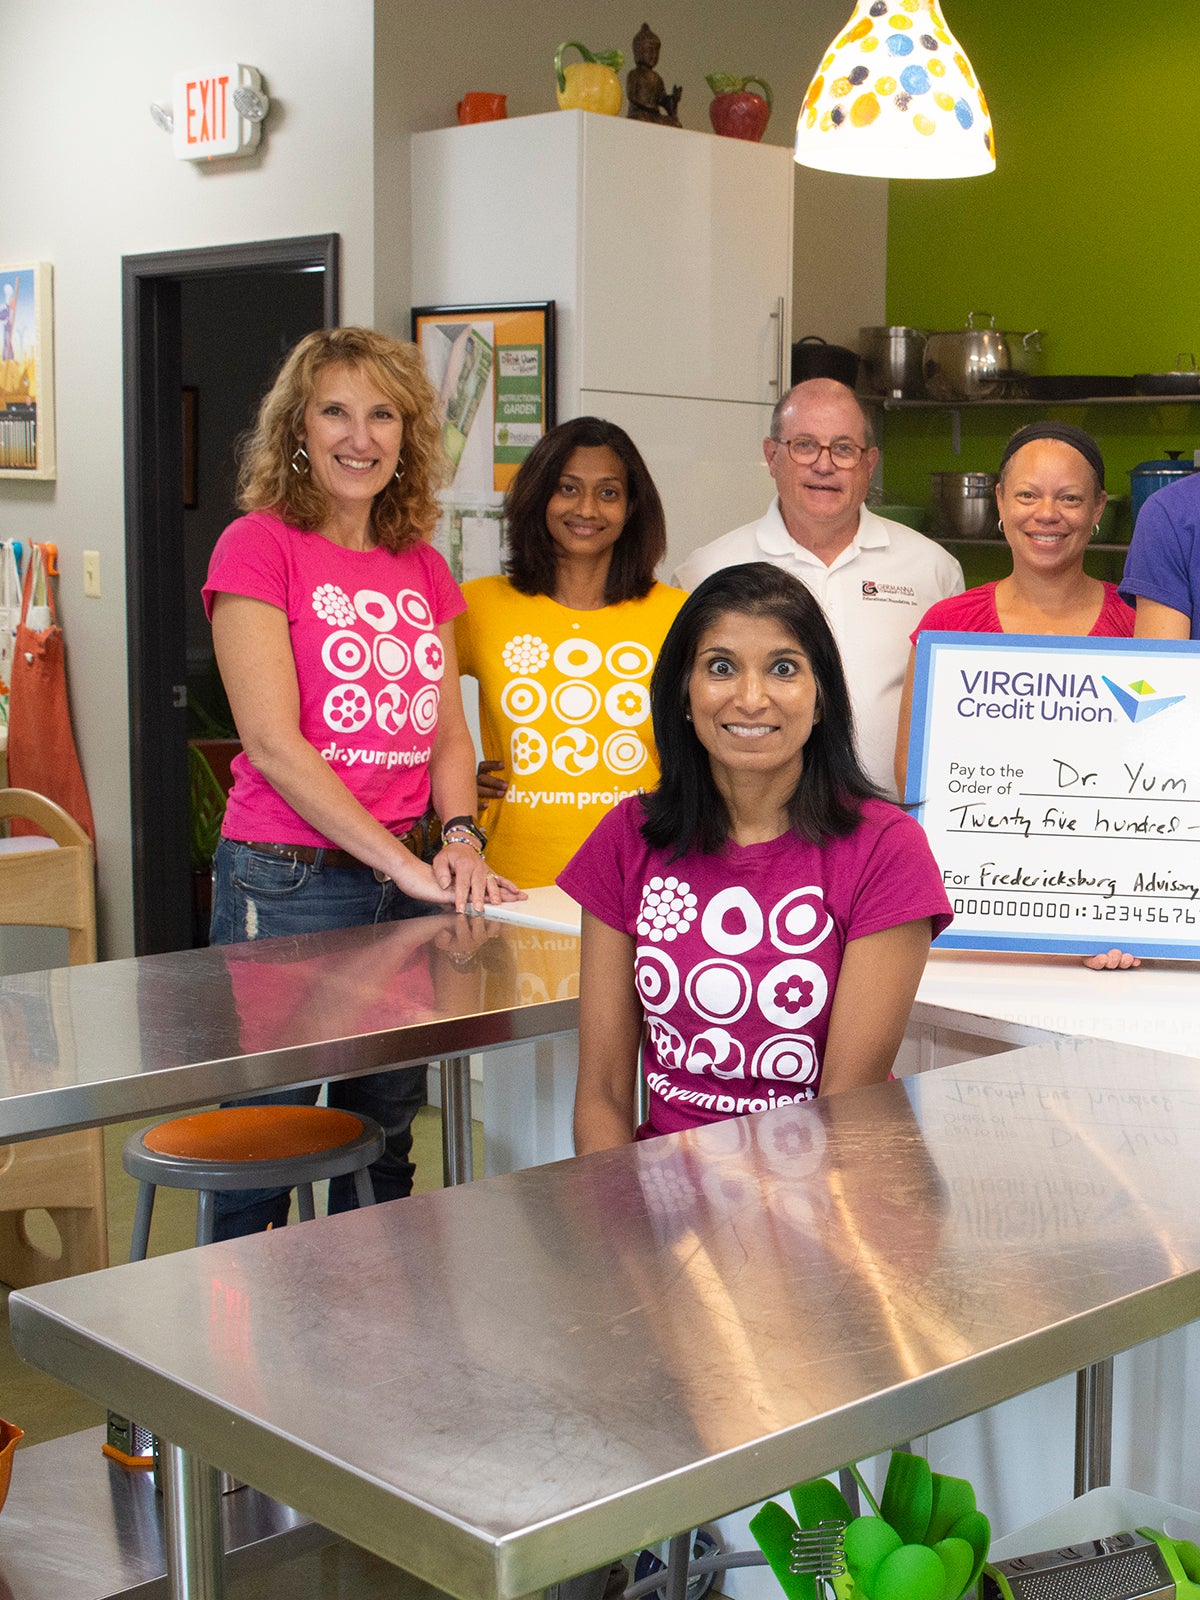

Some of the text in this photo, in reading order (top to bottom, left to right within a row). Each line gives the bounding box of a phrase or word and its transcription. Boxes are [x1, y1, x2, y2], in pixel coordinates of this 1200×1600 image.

[187, 76, 229, 144] EXIT
[503, 403, 537, 415] GARDEN
[877, 583, 914, 593] GERMANNA
[960, 669, 1099, 699] VIRGINIA
[957, 697, 1113, 723] Credit Union
[949, 762, 1024, 779] Pay to the
[1052, 758, 1098, 788] Dr.
[1123, 762, 1187, 794] Yum
[505, 784, 575, 809] dr.yum
[948, 779, 1012, 795] Order of
[950, 803, 1180, 838] Twenty five hundred
[943, 870, 970, 886] For
[979, 862, 1117, 899] Fredericksburg
